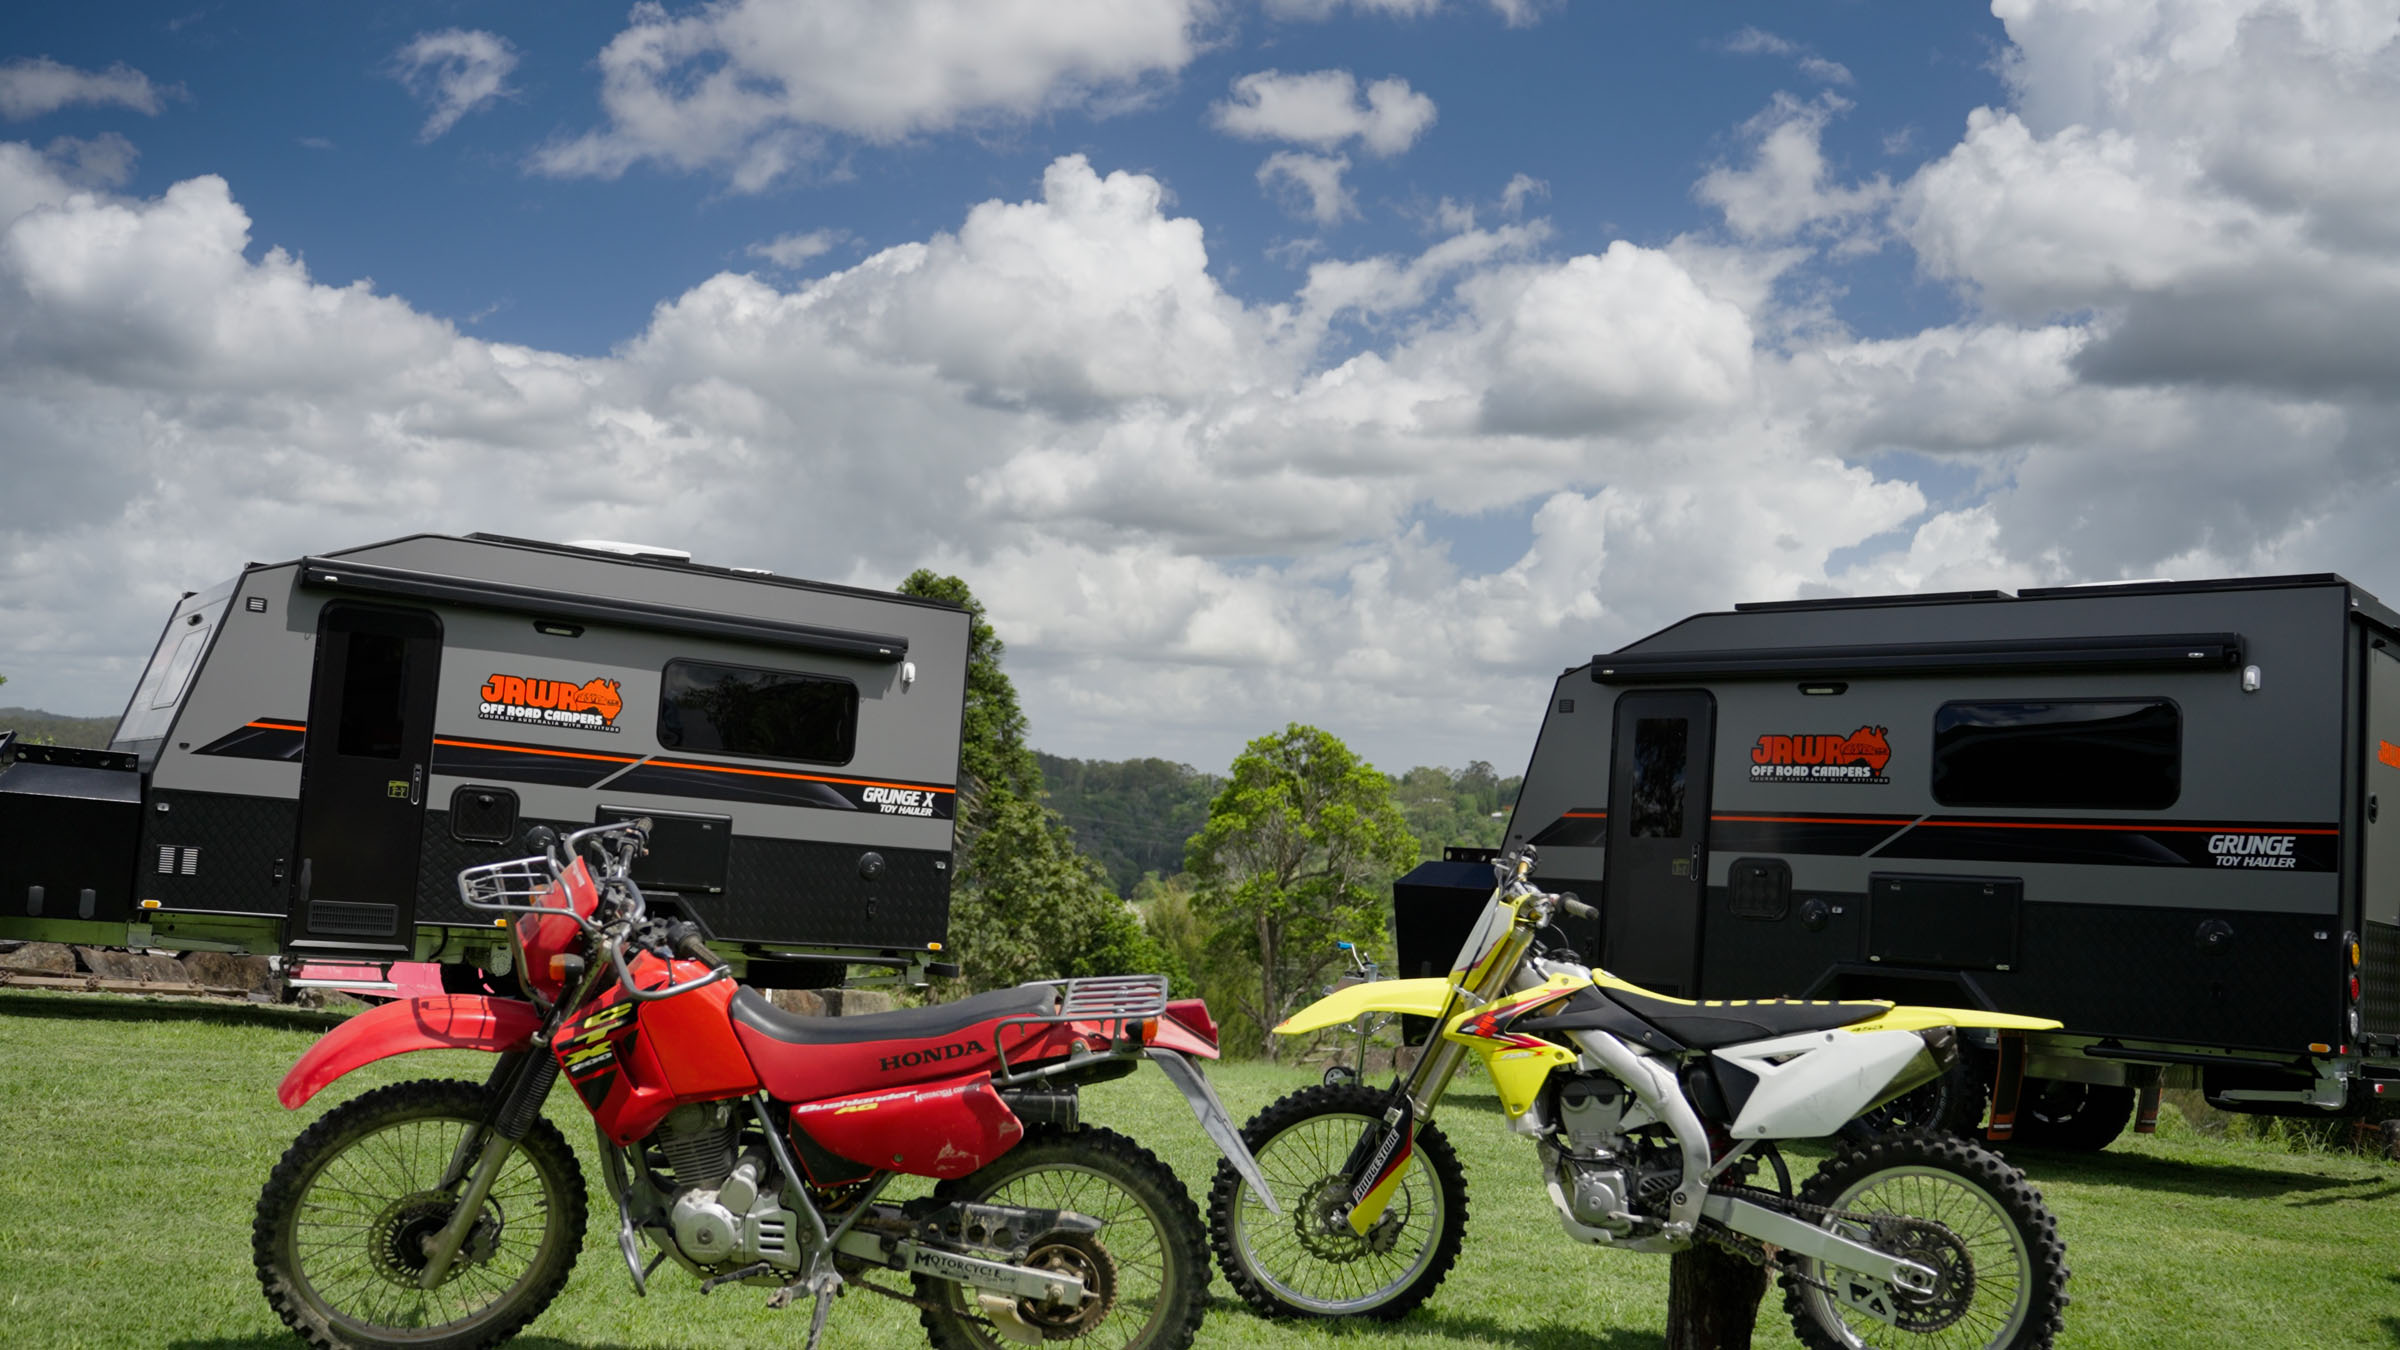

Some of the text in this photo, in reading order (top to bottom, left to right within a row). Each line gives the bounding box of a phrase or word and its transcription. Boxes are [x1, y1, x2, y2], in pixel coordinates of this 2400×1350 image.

[480, 703, 603, 725] OFF ROAD CAMPERS
[518, 717, 559, 726] AUSTRALIA
[1751, 765, 1871, 778] OFF ROAD CAMPERS
[862, 786, 935, 807] GRUNGE X
[880, 804, 933, 817] TOY HAULER
[2207, 834, 2297, 855] GRUNGE
[2215, 856, 2296, 868] TOY HAULER
[879, 1040, 987, 1072] HONDA
[798, 1090, 918, 1113] Bushlander
[1353, 1129, 1399, 1201] BRIDGESTONE
[915, 1251, 1001, 1278] MOTORCYCLE
